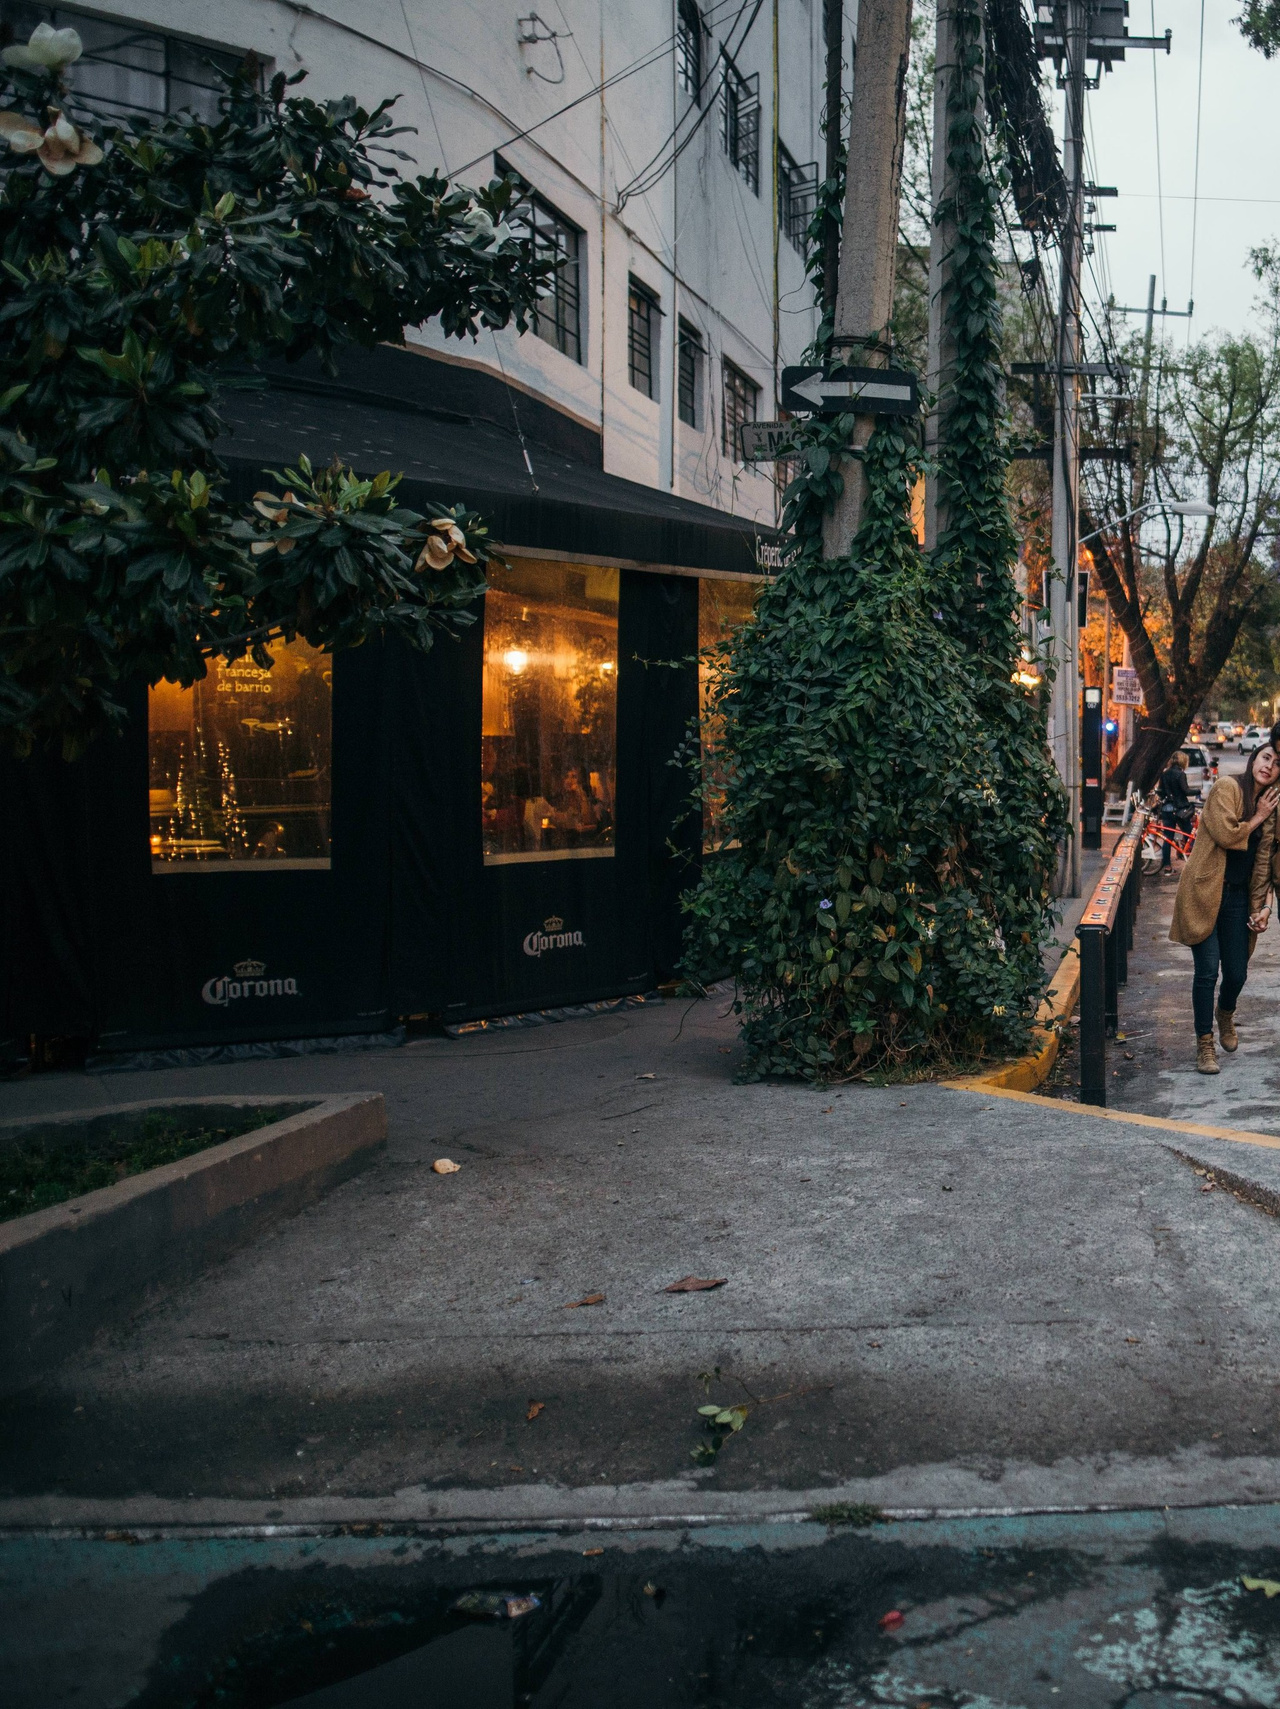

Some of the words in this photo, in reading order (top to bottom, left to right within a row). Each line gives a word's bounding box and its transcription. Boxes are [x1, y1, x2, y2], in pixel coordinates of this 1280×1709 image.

[752, 422, 785, 430] AVENIDA
[217, 681, 232, 692] de
[234, 681, 272, 693] barrio
[523, 930, 583, 958] Corona
[201, 975, 299, 1008] Corona
